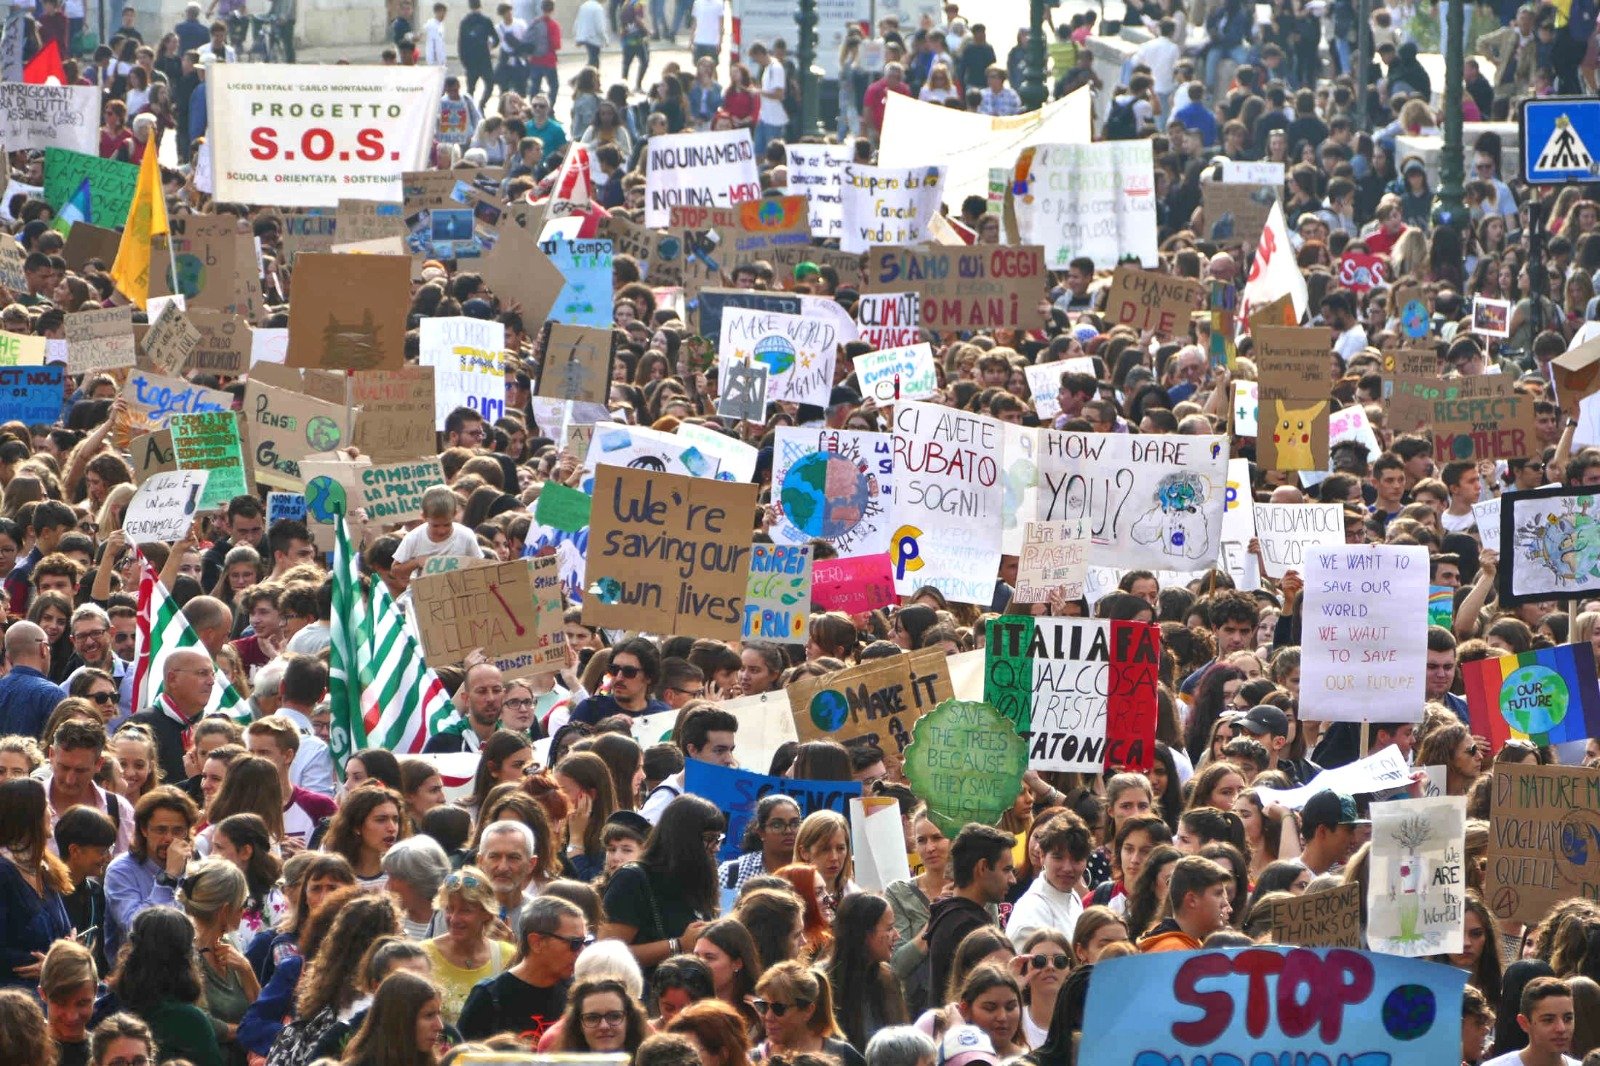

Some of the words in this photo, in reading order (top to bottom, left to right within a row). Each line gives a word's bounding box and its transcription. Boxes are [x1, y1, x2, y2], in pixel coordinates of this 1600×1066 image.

[227, 83, 253, 91] LICEO
[256, 83, 293, 92] STATALE
[251, 102, 402, 118] PROGETTO
[250, 126, 400, 162] S.O.S.
[226, 171, 268, 183] SCUOLA
[274, 173, 337, 184] ORIENTATA
[845, 166, 899, 196] Sciopero
[672, 206, 707, 228] STOP
[860, 223, 892, 243] vado
[566, 238, 612, 260] tempo
[879, 252, 949, 284] SIAMO
[990, 249, 1038, 279] OGGI
[1122, 273, 1195, 303] CHANGE
[859, 291, 921, 327] CLIMATE
[1119, 300, 1176, 334] DIE
[728, 314, 780, 345] MAKE
[786, 319, 836, 353] WORLD
[12, 388, 29, 398] OR
[783, 358, 831, 401] AGAIN
[1433, 396, 1520, 423] RESPECT
[897, 407, 920, 434] CI
[933, 413, 995, 450] AVETE
[1472, 421, 1499, 431] YOUR
[893, 435, 997, 488] RUBATO
[1047, 434, 1106, 462] HOW
[1131, 442, 1190, 467] DARE
[364, 487, 383, 502] LA
[613, 476, 726, 533] We're
[907, 480, 988, 519] SOGNI!
[364, 500, 398, 519] NON
[602, 530, 696, 579] saving
[700, 540, 752, 574] our
[1319, 554, 1338, 571] WE
[1346, 553, 1383, 571] WANT
[1394, 554, 1411, 571] TO
[1322, 580, 1353, 595] SAVE
[1360, 579, 1393, 596] OUR
[428, 593, 490, 623] ROTTO
[676, 581, 742, 624] lives
[1321, 603, 1369, 618] WORLD
[992, 622, 1111, 663] ITALIA
[1115, 626, 1159, 665] FA
[1317, 625, 1339, 643] WE
[1348, 625, 1391, 643] WANT
[1328, 649, 1352, 664] TO
[1361, 649, 1398, 664] SAVE
[990, 659, 1158, 699] QUALCOSA
[1325, 674, 1355, 691] OUR
[1366, 674, 1417, 691] FUTURE
[1515, 682, 1546, 698] OUR
[845, 680, 908, 726] MAKE
[1042, 693, 1148, 736] RESTARE
[1507, 694, 1554, 711] FUTURE
[948, 706, 989, 727] SAVE
[930, 725, 957, 748] THE
[963, 730, 1009, 751] TREES
[927, 748, 1009, 775] BECAUSE
[931, 772, 967, 797] THEY
[968, 775, 1002, 799] SAVE
[1495, 771, 1513, 803] DI
[1519, 773, 1582, 811] NATURE
[1495, 818, 1576, 854] VOGLIAMO
[1443, 846, 1461, 865] We
[1431, 865, 1462, 887] ARE
[1495, 856, 1562, 892] QUELLE
[1272, 884, 1360, 925] EVERYONE
[1442, 889, 1461, 906] the
[1274, 916, 1342, 945] THINKS
[1342, 909, 1360, 930] OF
[1422, 904, 1463, 927] World!
[1170, 947, 1376, 1048] STOP
